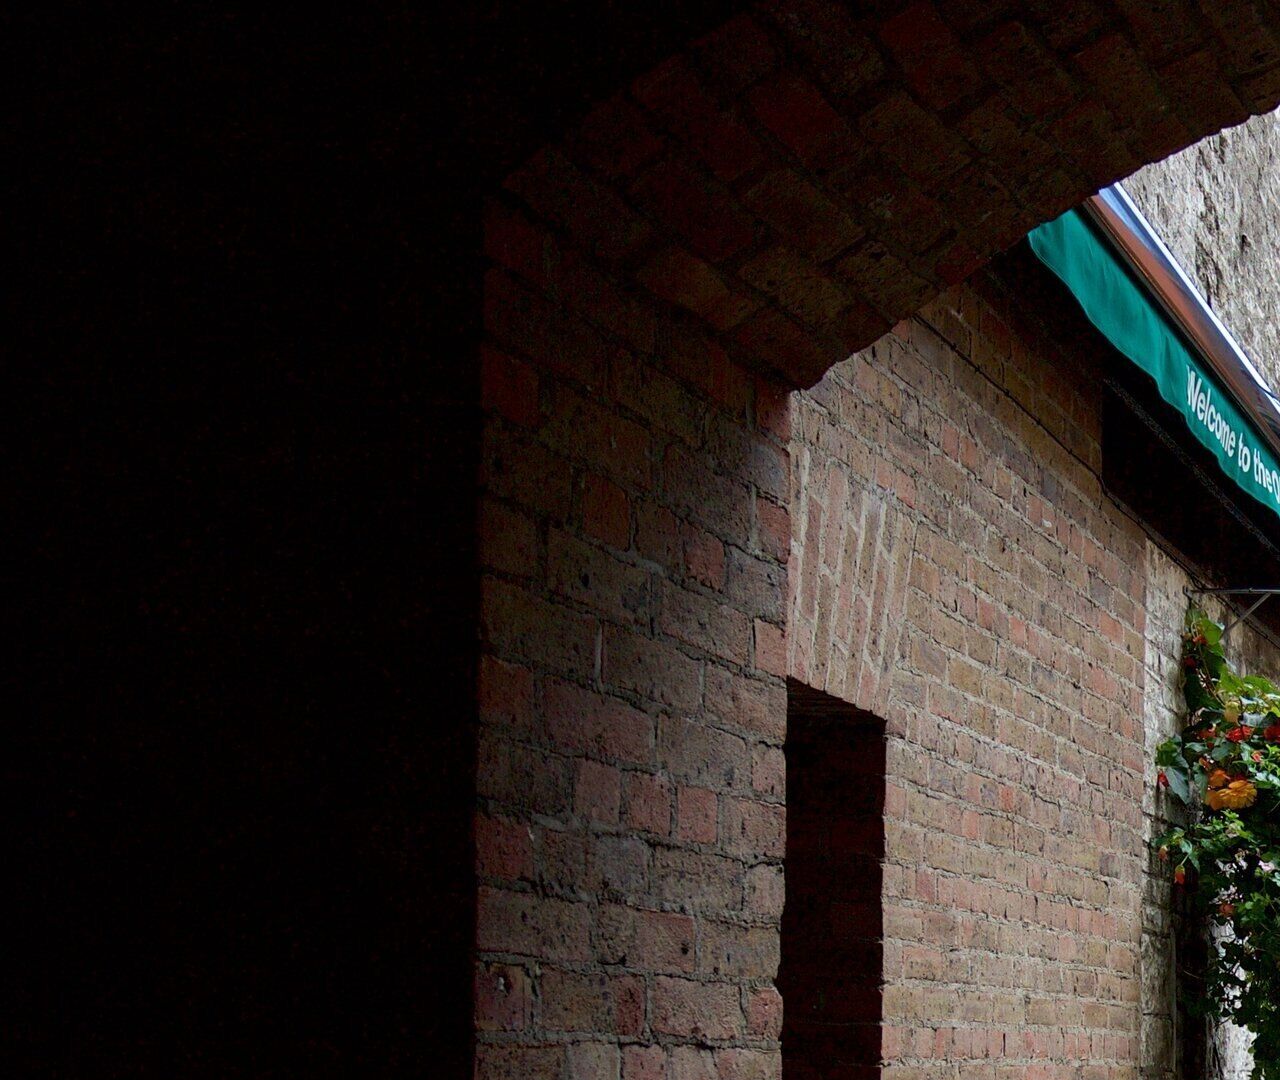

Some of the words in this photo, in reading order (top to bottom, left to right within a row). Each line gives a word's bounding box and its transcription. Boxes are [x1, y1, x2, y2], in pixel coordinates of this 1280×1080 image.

[1186, 364, 1236, 458] Welcome
[1238, 432, 1251, 473] to
[1253, 448, 1273, 493] the
